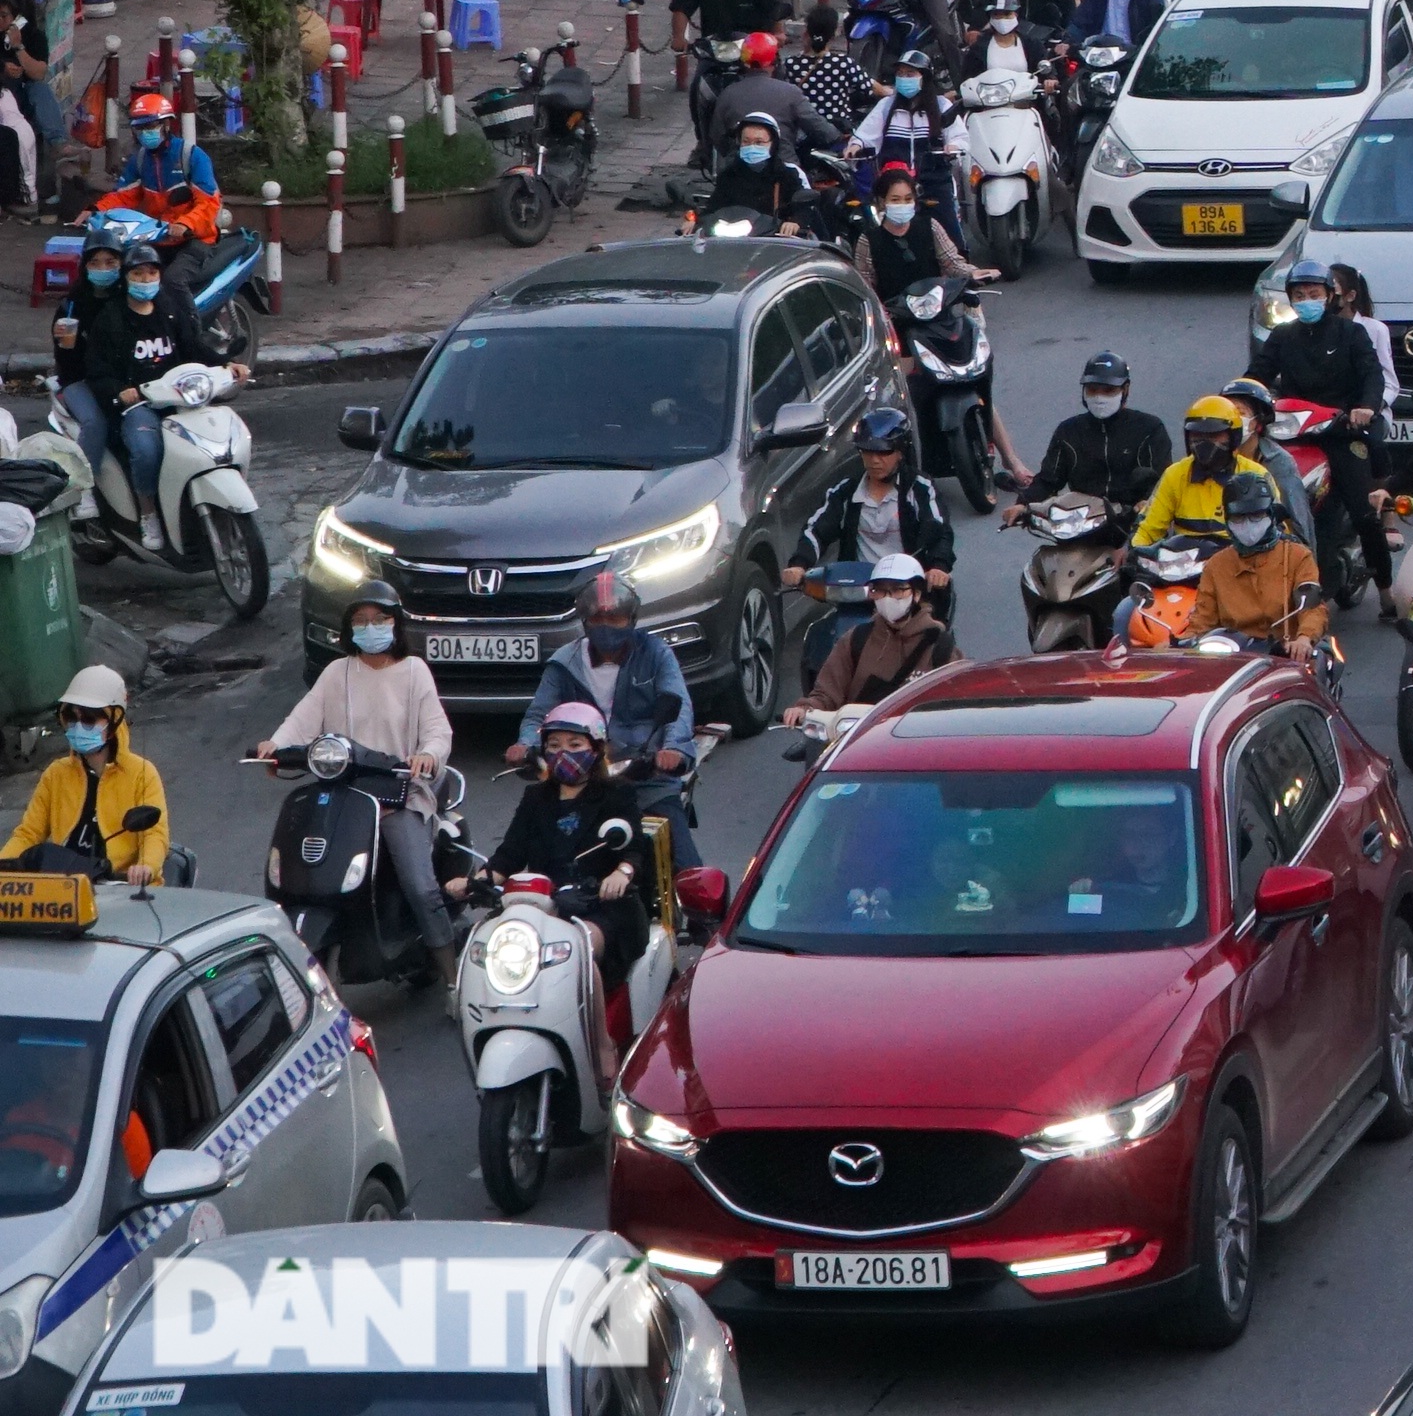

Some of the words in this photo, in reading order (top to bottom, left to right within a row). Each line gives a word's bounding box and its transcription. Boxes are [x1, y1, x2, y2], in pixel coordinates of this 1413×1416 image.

[1199, 205, 1226, 220] 89A
[1190, 220, 1237, 234] 136.46
[428, 637, 536, 660] 30A-449.35
[0, 881, 34, 896] AXI
[31, 902, 73, 919] NGA
[801, 1256, 942, 1284] 18A-206.81
[97, 1395, 111, 1406] XE
[114, 1393, 139, 1404] HỢP
